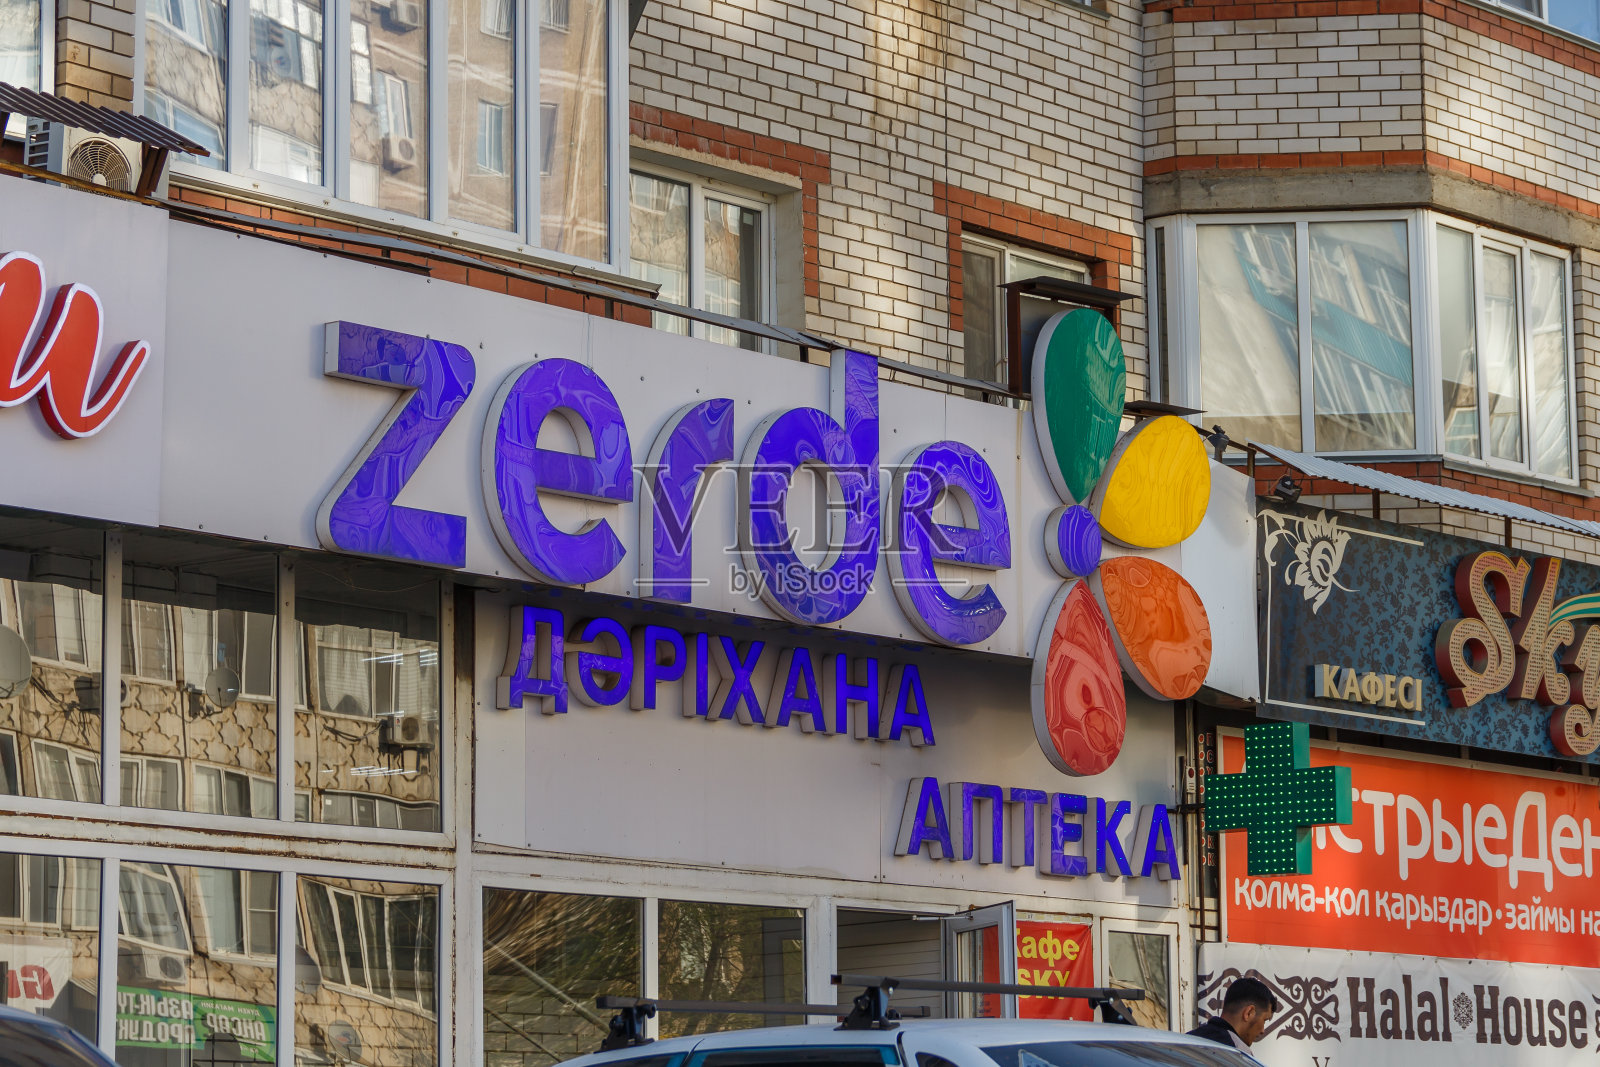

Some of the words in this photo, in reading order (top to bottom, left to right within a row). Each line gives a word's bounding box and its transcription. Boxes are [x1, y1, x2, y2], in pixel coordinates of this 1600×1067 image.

[318, 321, 1011, 645] zerde
[499, 606, 935, 746] ДӘРІХАНА
[1317, 664, 1423, 712] КАФЕСІ
[898, 777, 1181, 880] АПТЕКА
[1375, 890, 1492, 935] қарыздар
[1505, 896, 1575, 934] займы
[1346, 974, 1453, 1042] Halal
[1473, 985, 1588, 1048] House
